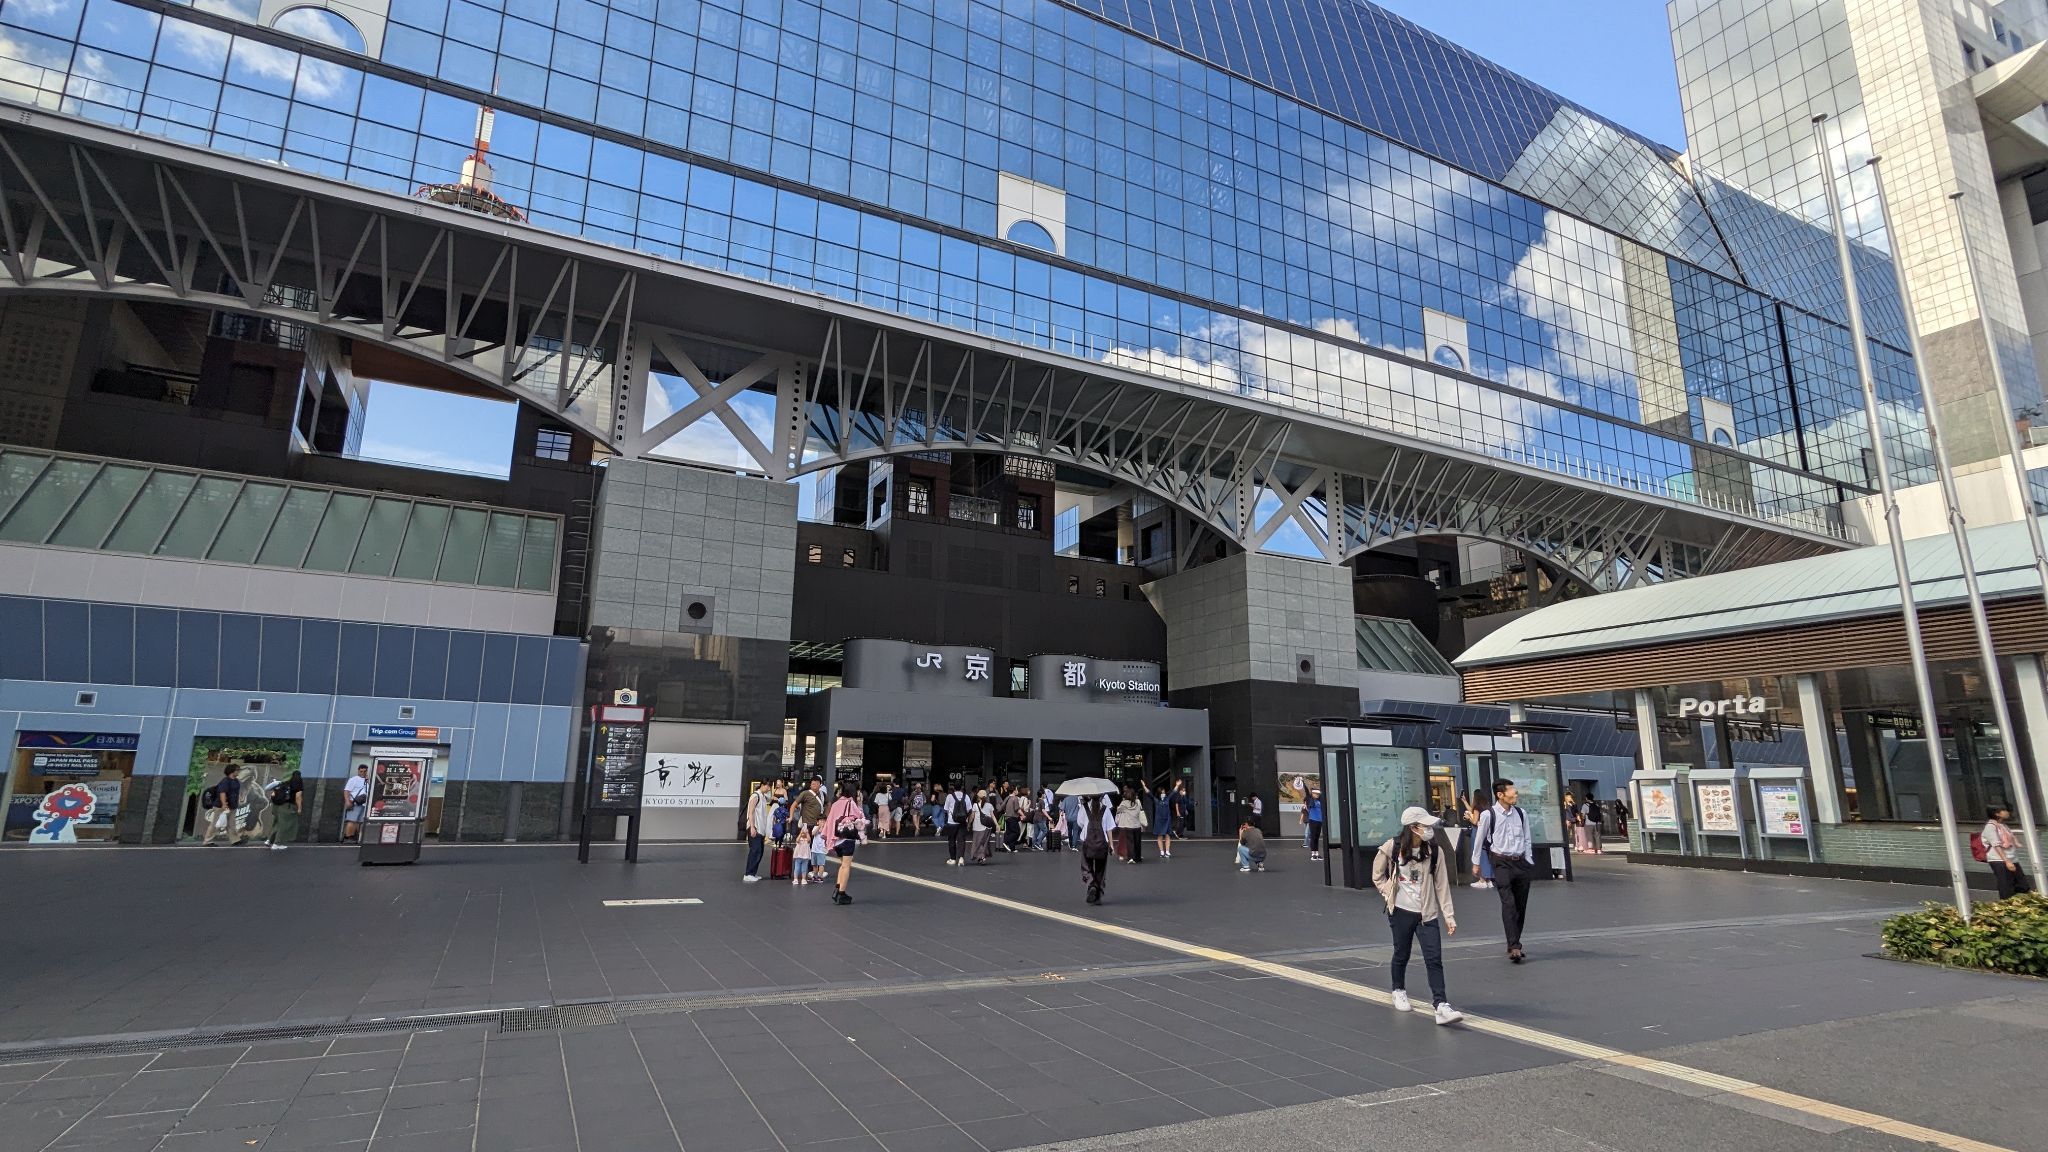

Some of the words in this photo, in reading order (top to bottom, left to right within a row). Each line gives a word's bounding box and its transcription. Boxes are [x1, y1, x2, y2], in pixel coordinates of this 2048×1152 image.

[916, 653, 942, 669] JR
[1099, 678, 1126, 692] Kyoto
[1127, 680, 1160, 692] Station
[1679, 694, 1766, 718] Porta
[398, 728, 416, 736] Group
[96, 735, 136, 745] 日本旅行
[678, 798, 715, 806] STATION
